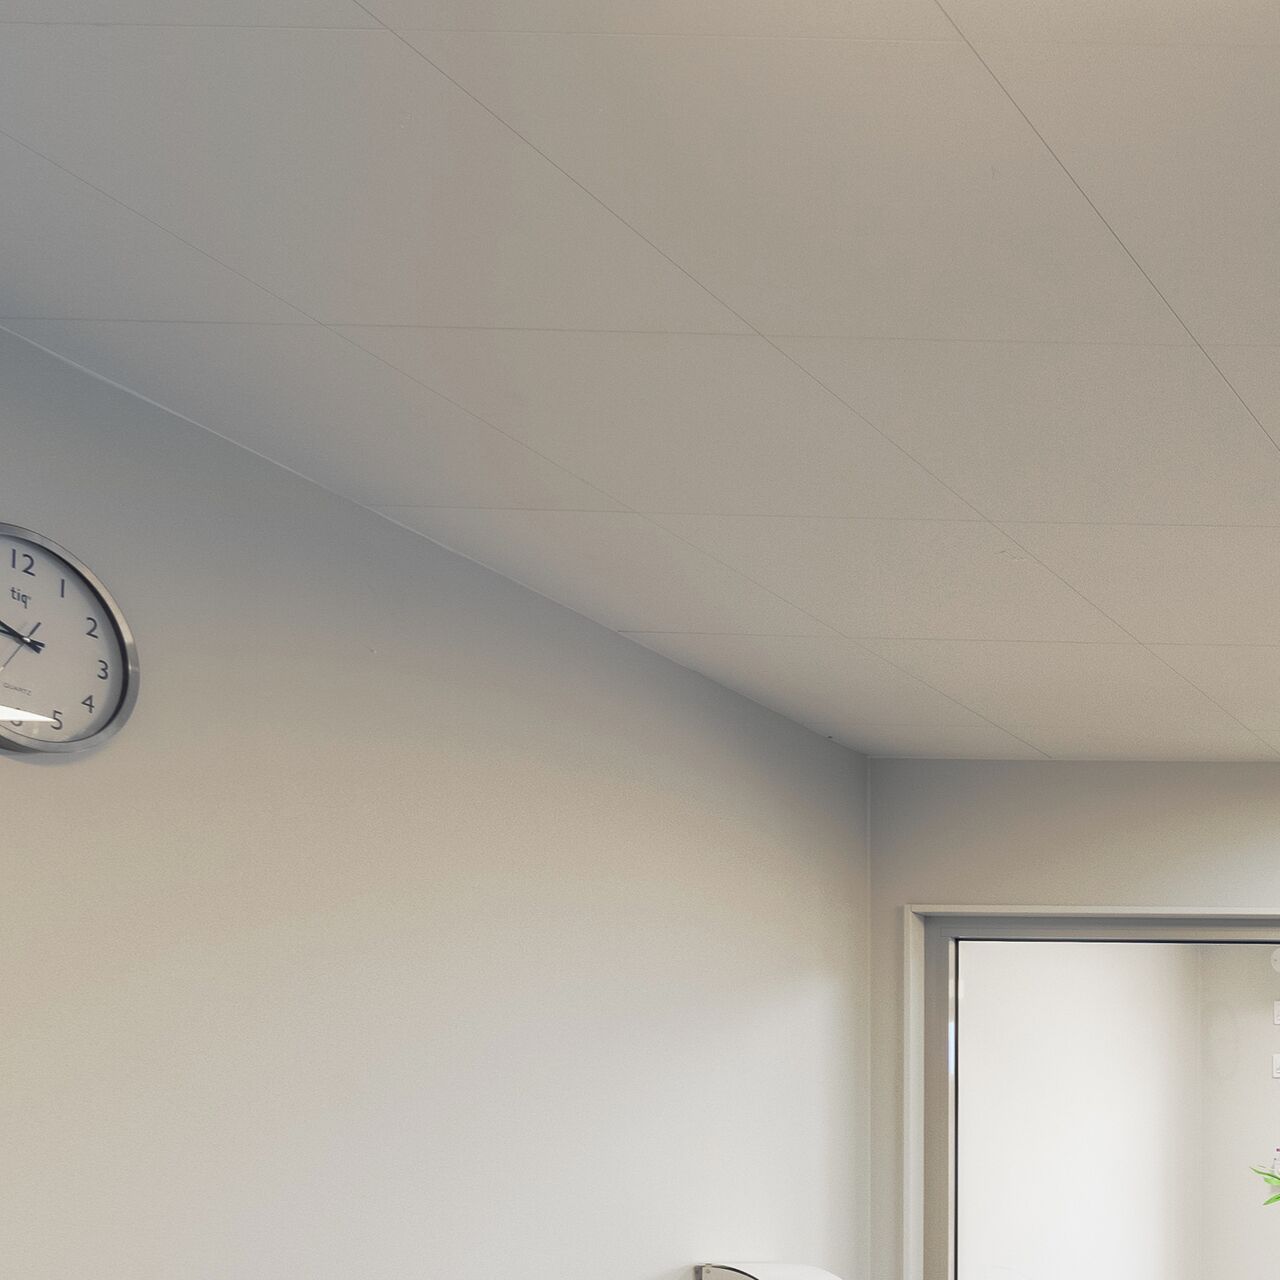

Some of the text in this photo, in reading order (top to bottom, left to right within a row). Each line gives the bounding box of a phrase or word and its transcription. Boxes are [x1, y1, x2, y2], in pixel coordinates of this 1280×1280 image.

[12, 549, 36, 576] 12
[60, 579, 65, 598] 1
[86, 617, 98, 638] 2
[97, 660, 109, 680] 3
[81, 695, 95, 713] 4
[50, 709, 63, 730] 5
